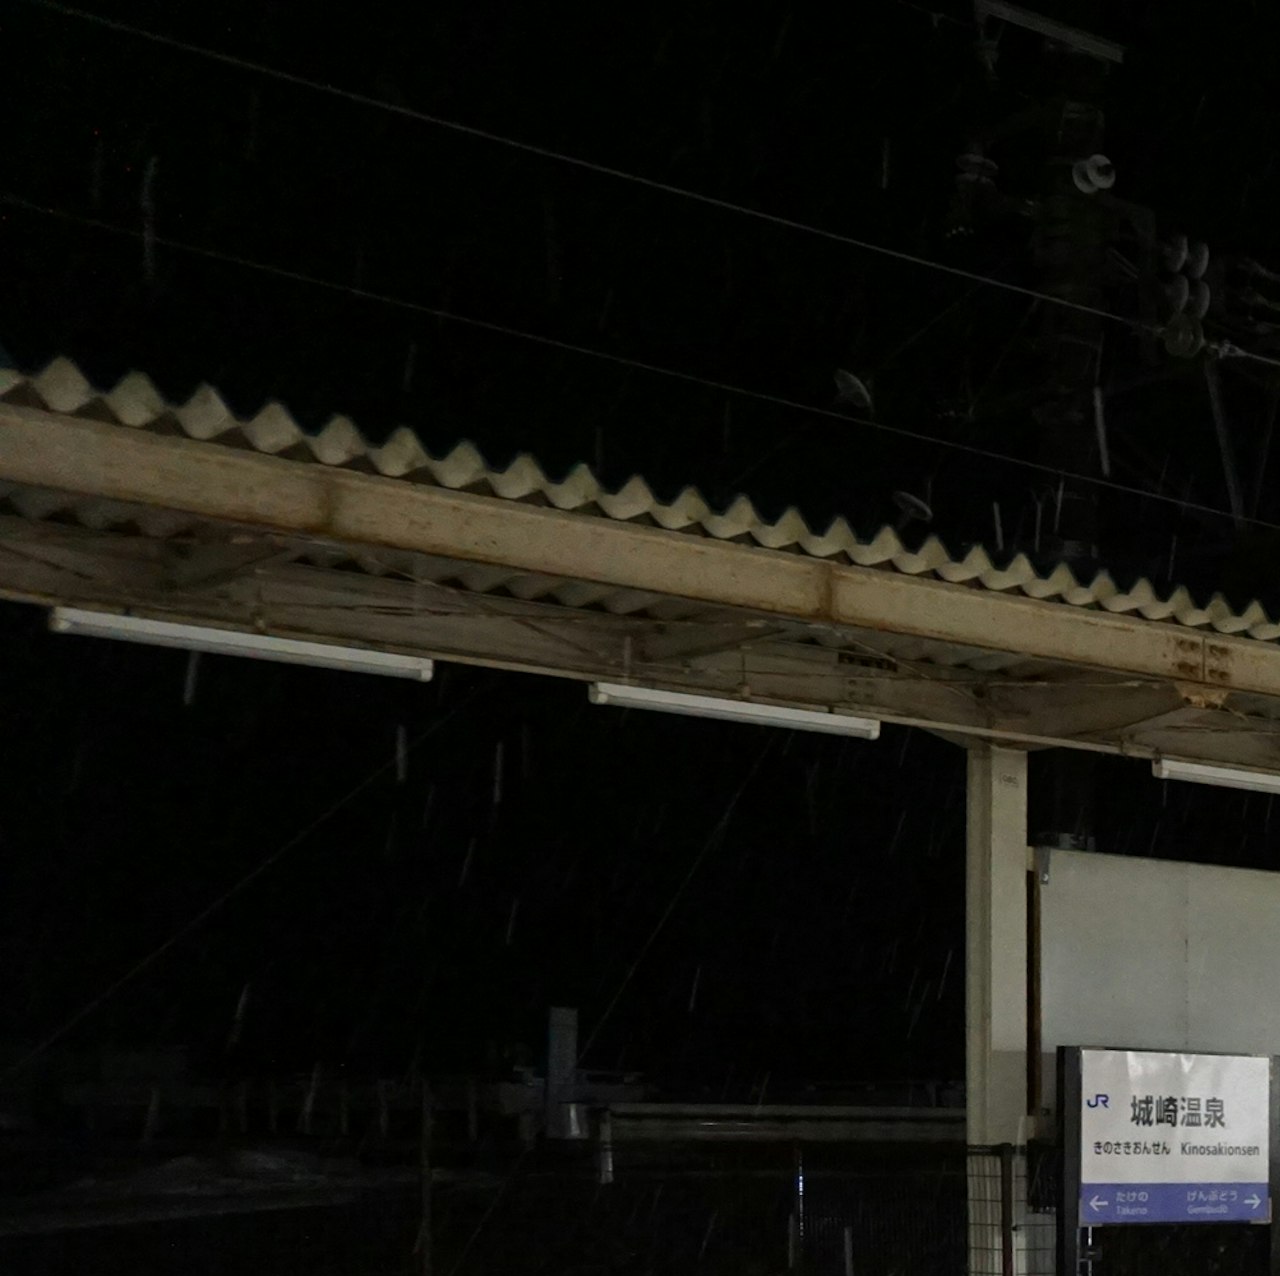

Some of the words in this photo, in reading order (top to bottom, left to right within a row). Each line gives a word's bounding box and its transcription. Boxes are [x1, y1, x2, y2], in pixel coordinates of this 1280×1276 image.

[1086, 1093, 1109, 1109] JR
[1130, 1095, 1226, 1128] 城崎温泉
[1093, 1141, 1172, 1155] きのさきおんせん
[1180, 1142, 1260, 1156] Kinosakionsen
